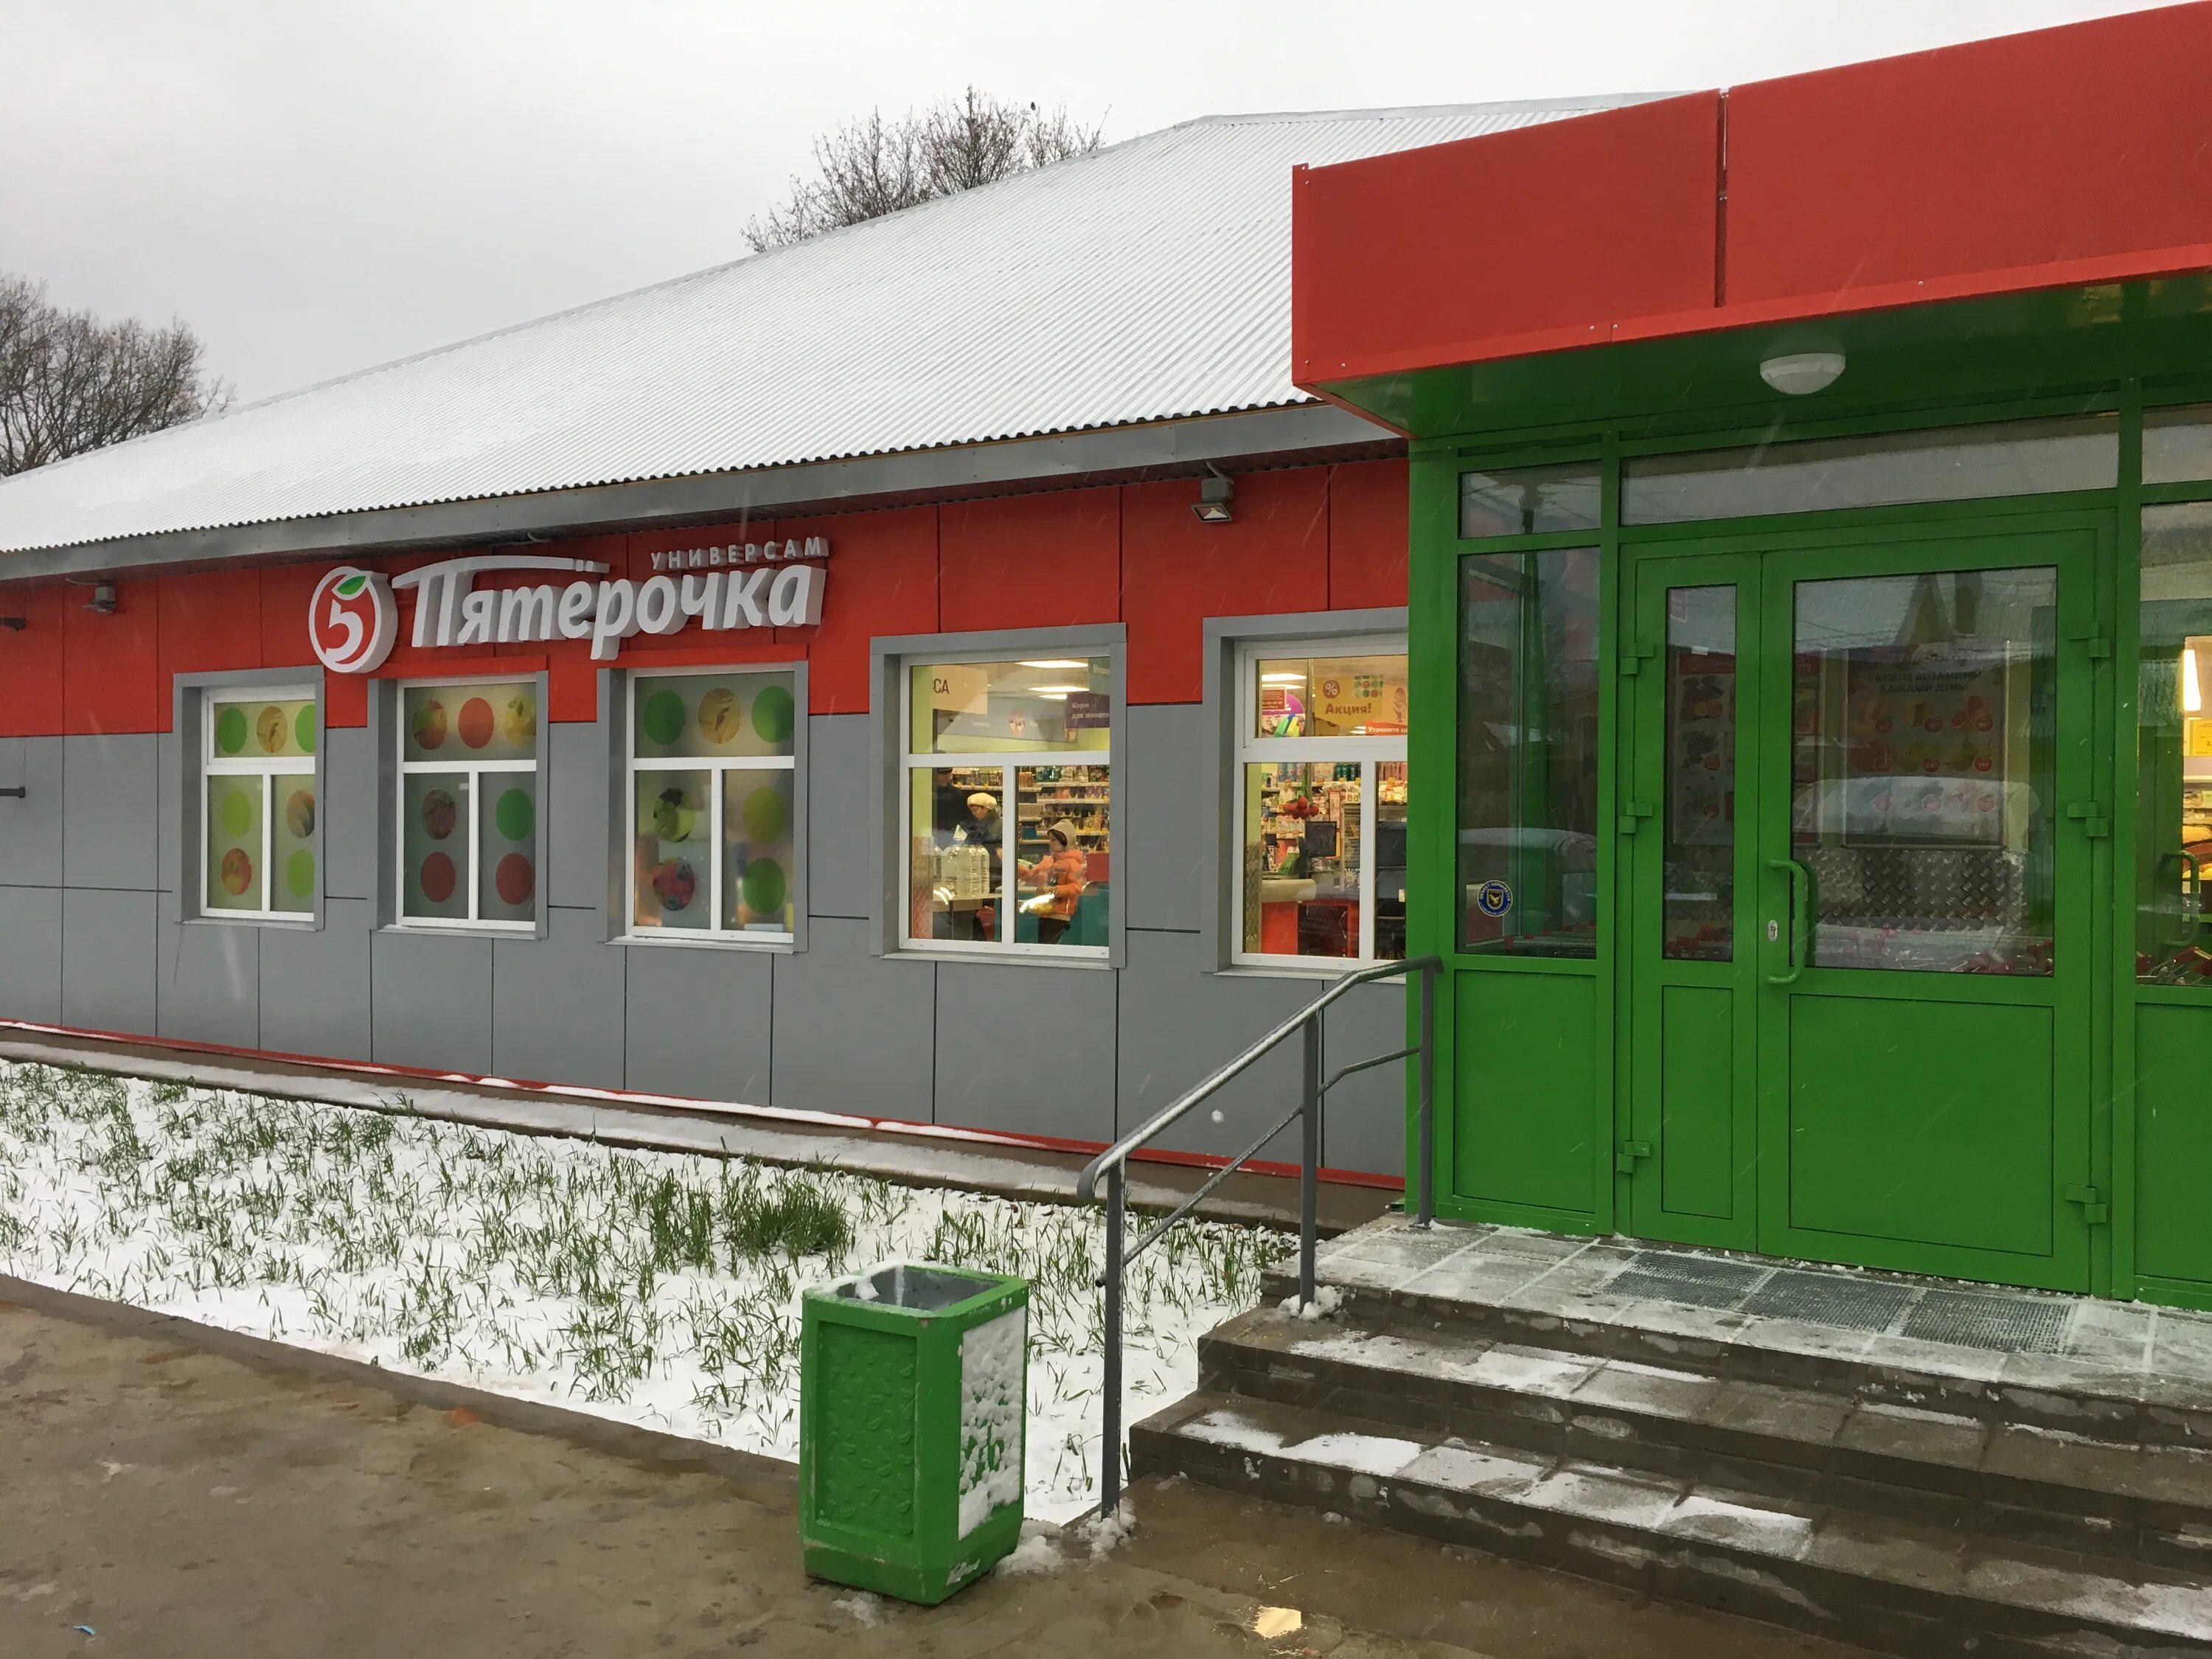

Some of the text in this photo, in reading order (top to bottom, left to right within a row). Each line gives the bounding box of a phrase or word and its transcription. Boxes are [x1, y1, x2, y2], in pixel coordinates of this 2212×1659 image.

[650, 536, 827, 570] УНИВЕРСАМ
[391, 554, 821, 661] Пятёрочка
[932, 678, 950, 695] СА
[1072, 702, 1090, 711] Корм
[1325, 703, 1371, 716] Акция!
